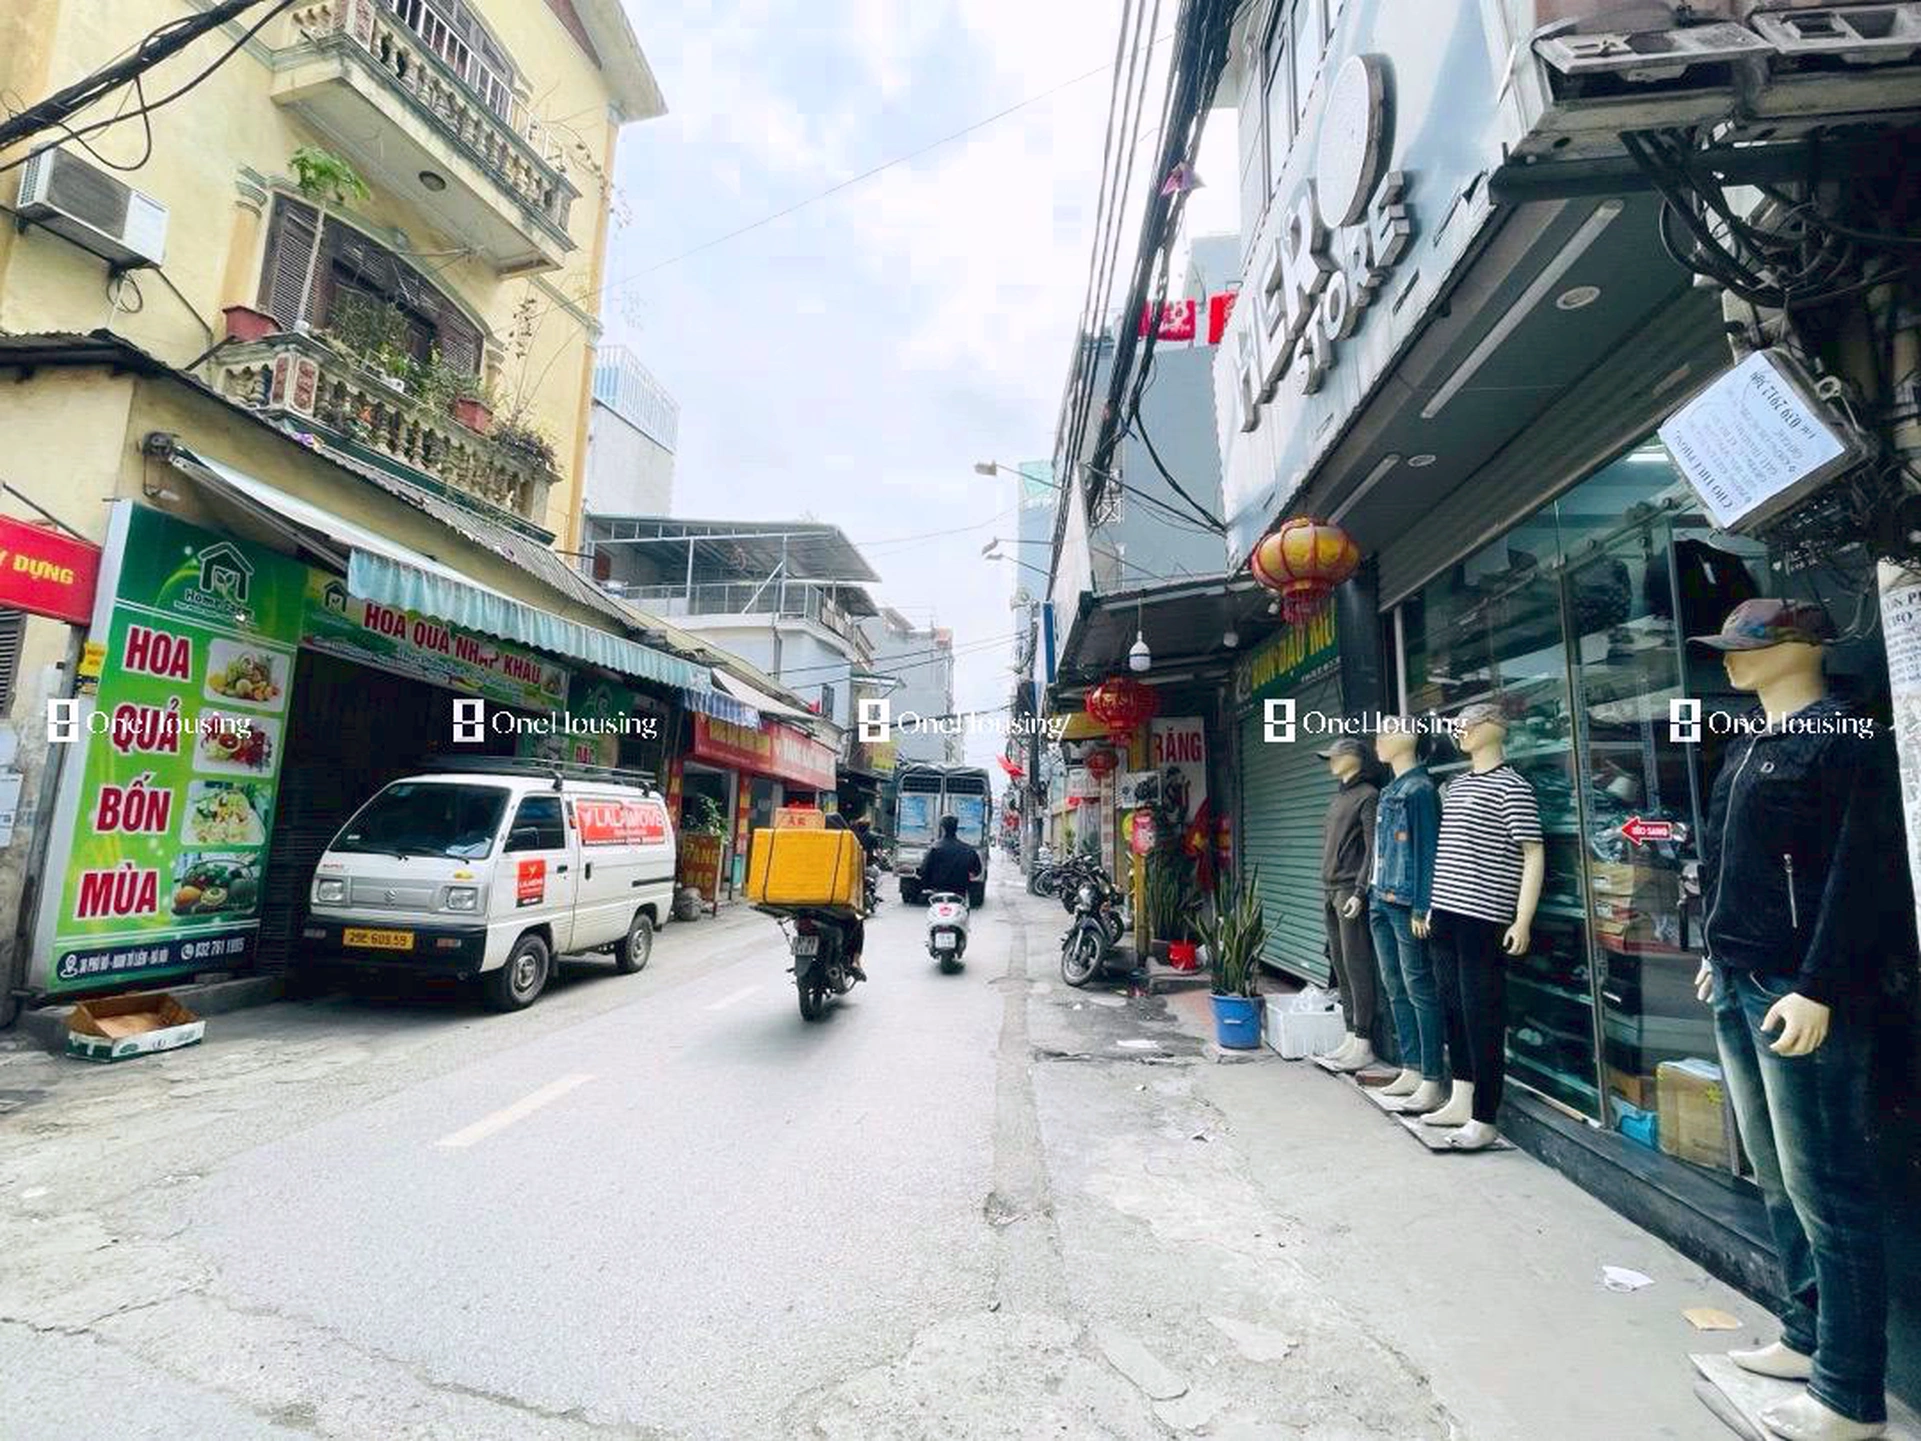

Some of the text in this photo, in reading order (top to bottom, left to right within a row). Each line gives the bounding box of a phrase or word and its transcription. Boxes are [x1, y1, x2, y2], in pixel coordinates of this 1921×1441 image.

[364, 602, 406, 641] HOA
[125, 627, 190, 680] HOA
[112, 697, 180, 754] QUẢ
[1152, 725, 1202, 763] RĂNG
[96, 771, 171, 833] BỐN
[78, 861, 158, 918] MÙA
